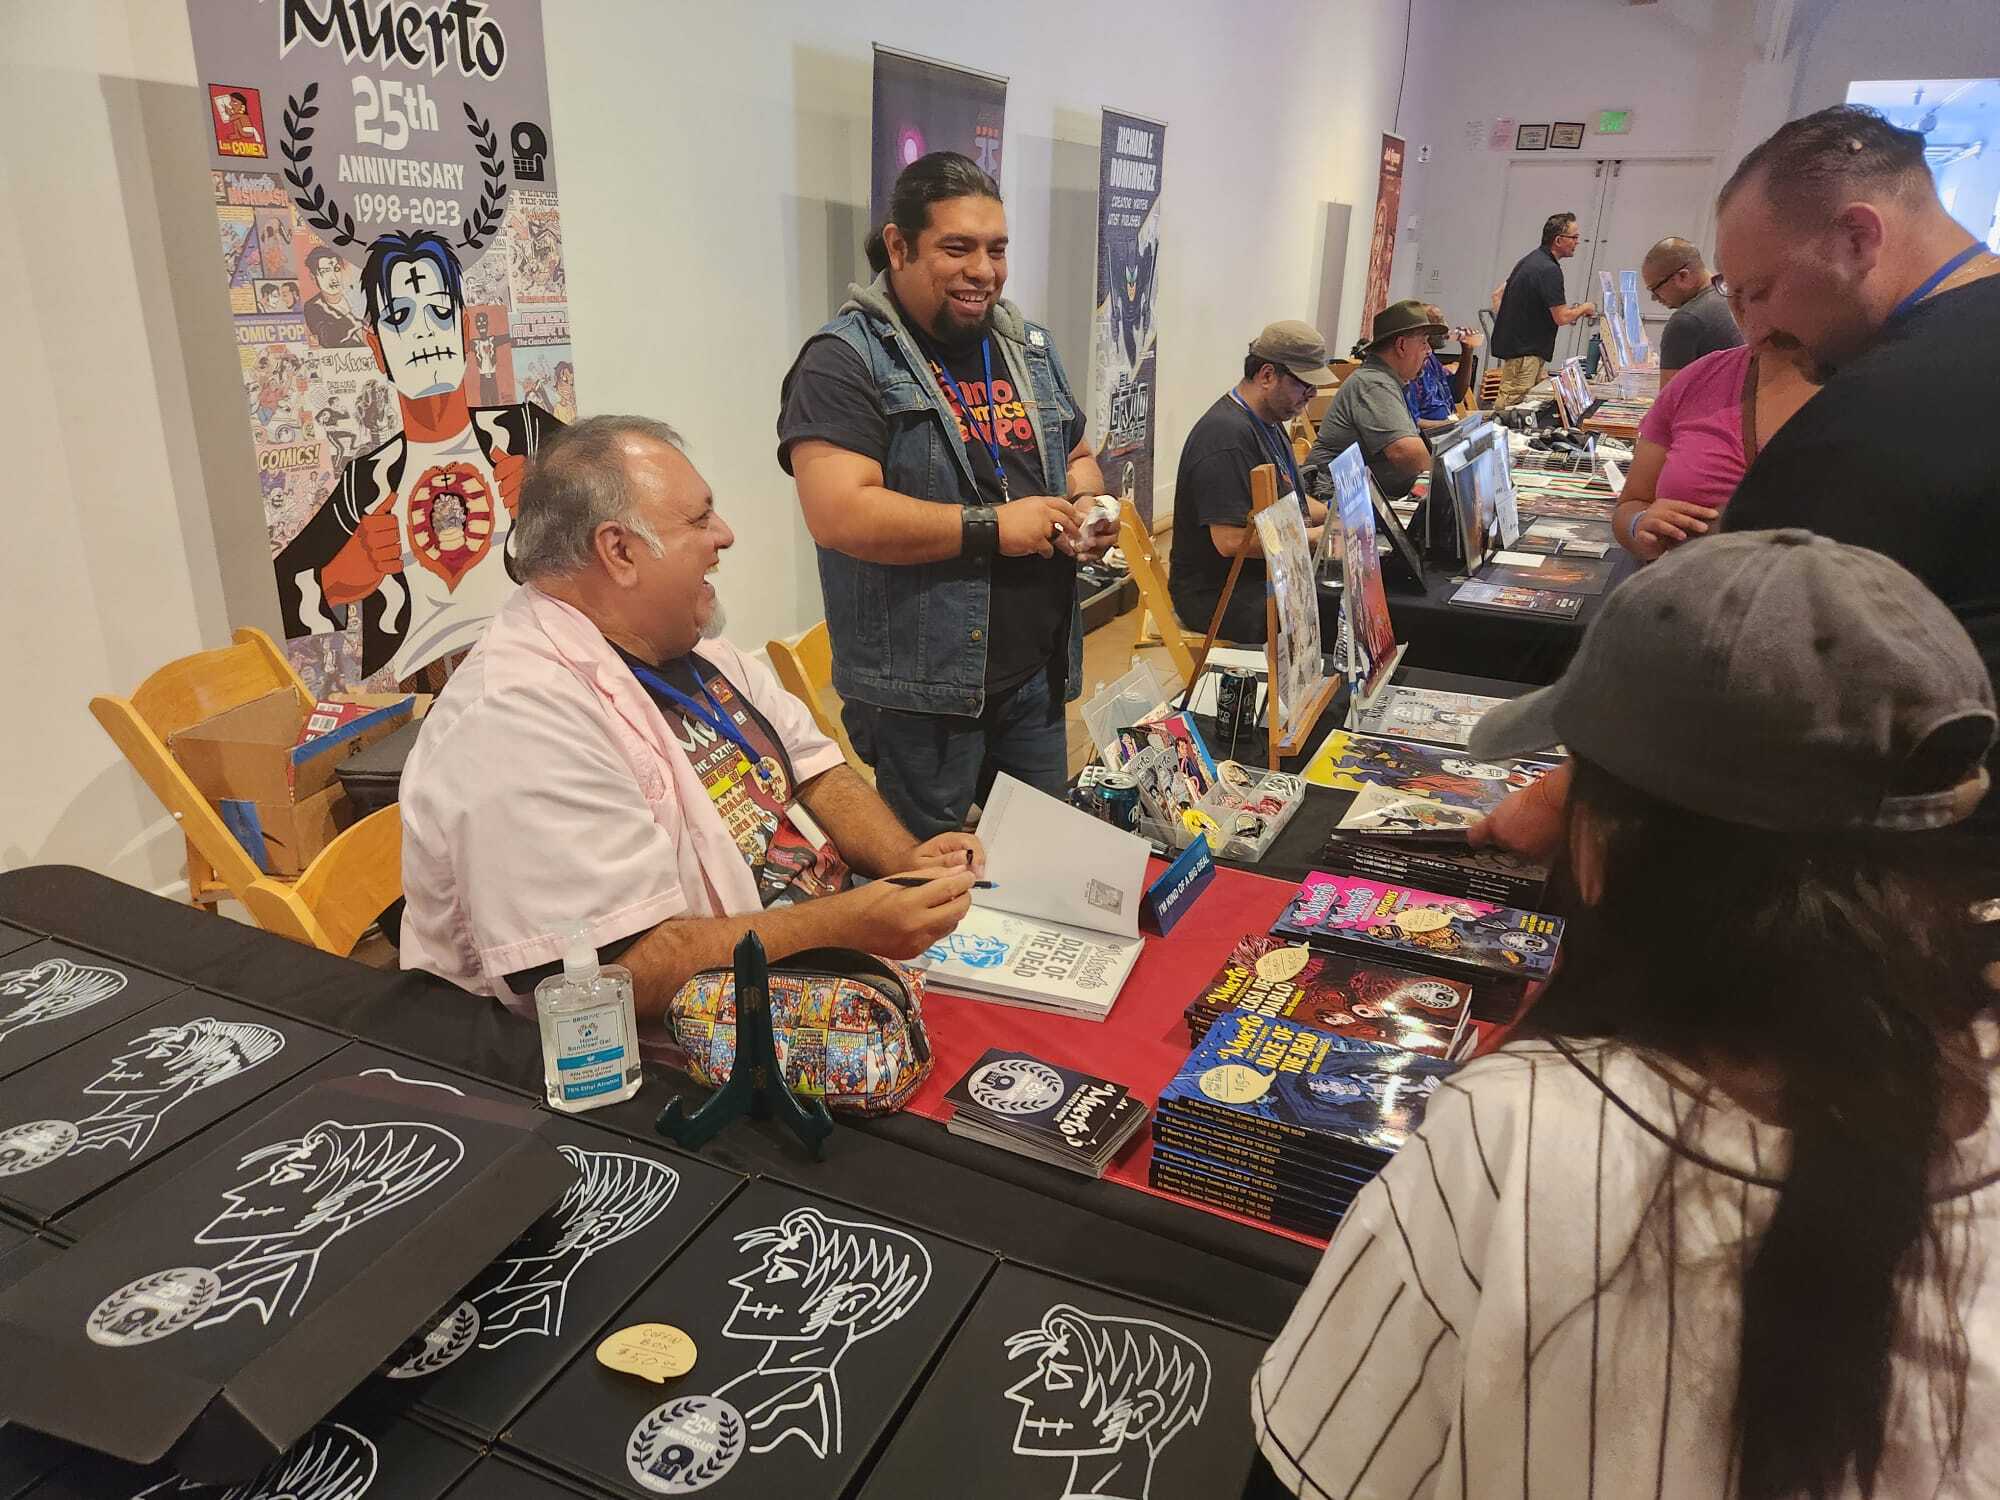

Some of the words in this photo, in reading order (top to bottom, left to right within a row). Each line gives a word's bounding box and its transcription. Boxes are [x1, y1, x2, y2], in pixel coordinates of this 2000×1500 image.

[351, 75, 440, 151] 25th
[338, 155, 465, 190] ANNIVERSARY
[1110, 158, 1156, 191] DOMINGUEZ
[353, 193, 462, 227] 1998-2023
[259, 445, 321, 470] COMICS!
[1399, 854, 1458, 870] COMEX
[1165, 889, 1179, 906] KIND
[1178, 882, 1186, 893] OF
[1184, 876, 1190, 887] A
[1188, 867, 1198, 882] BIG
[1197, 854, 1210, 873] DEAL
[1374, 888, 1398, 919] ORIGINS
[1032, 926, 1059, 953] THE
[1052, 935, 1081, 967] DAZE
[1014, 947, 1046, 980] DEAD
[1042, 962, 1066, 981] OF
[1210, 961, 1247, 1005] Muerto
[1252, 975, 1272, 993] DE
[1221, 1010, 1263, 1060] Muerto
[1256, 1037, 1286, 1070] DAZE
[1271, 1023, 1294, 1044] OF
[1289, 1029, 1318, 1059] DEAD
[1279, 1051, 1306, 1078] THE
[1059, 1081, 1111, 1142] Muerto
